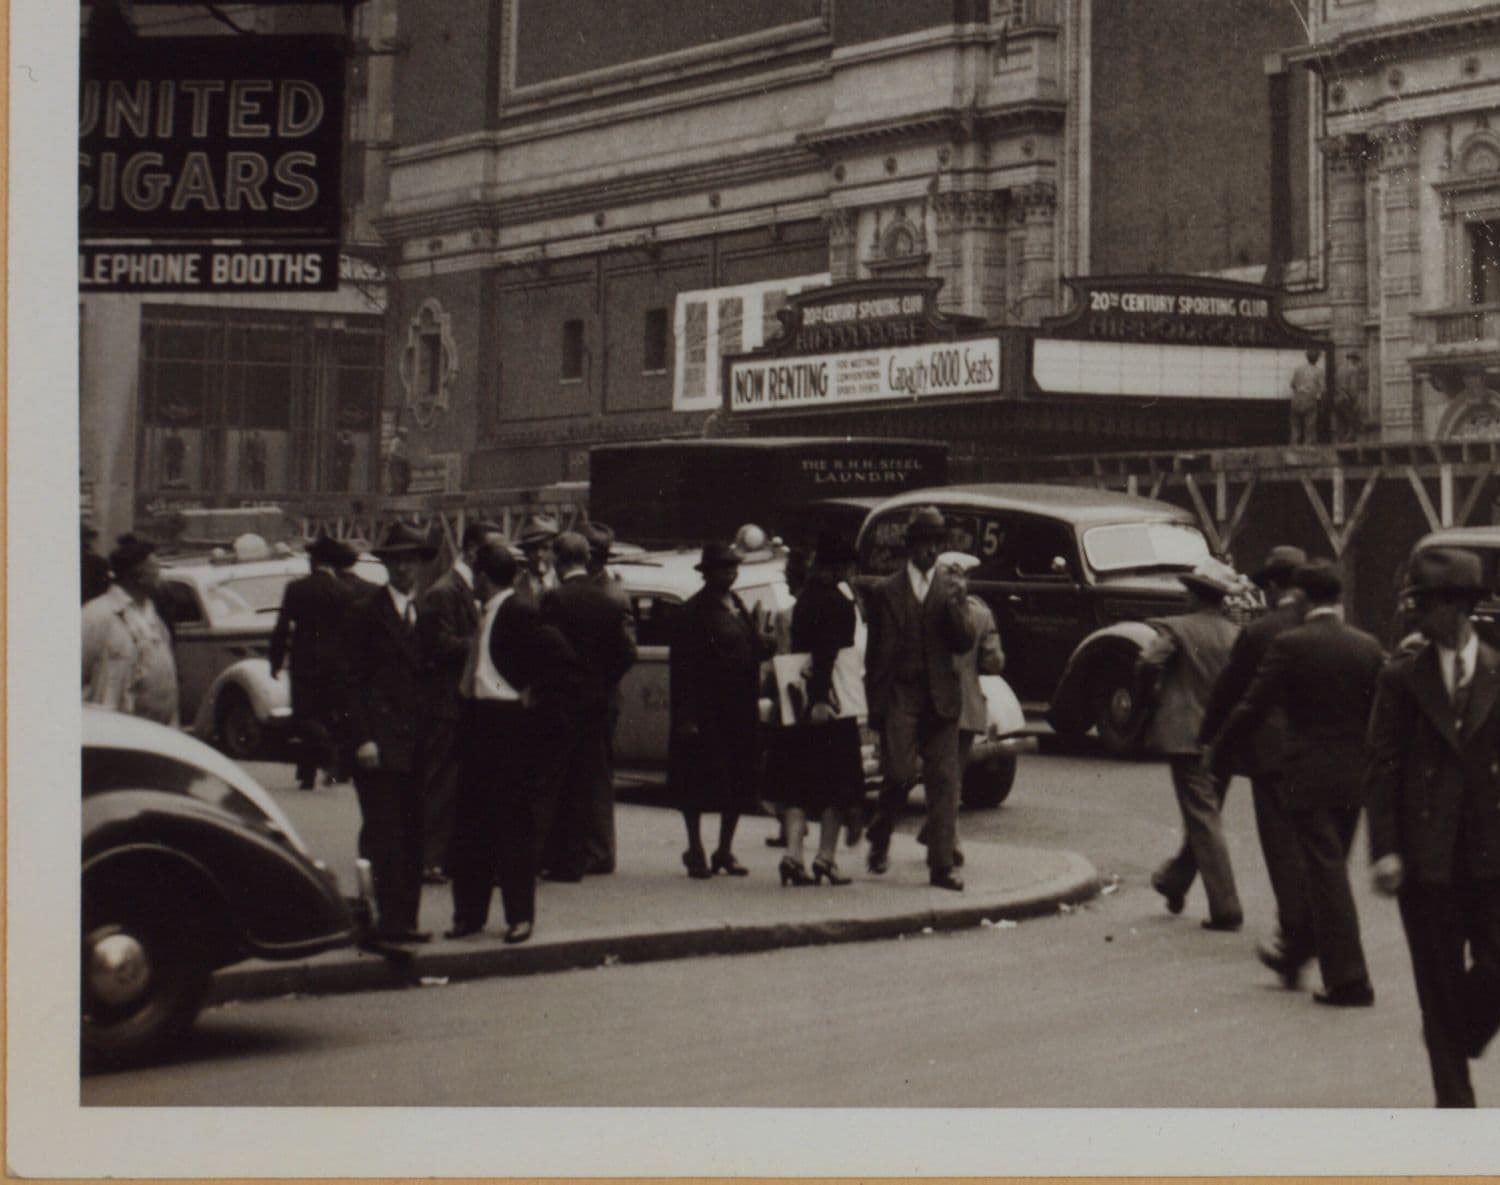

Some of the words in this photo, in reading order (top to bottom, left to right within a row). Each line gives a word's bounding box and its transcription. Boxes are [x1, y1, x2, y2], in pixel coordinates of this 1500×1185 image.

[80, 152, 319, 212] IGARS
[212, 254, 322, 285] BOOTHS
[1121, 293, 1177, 314] CENTURY
[1178, 296, 1237, 317] SPORTING
[1239, 299, 1269, 318] CLUB
[735, 368, 766, 404] NOW
[768, 362, 829, 402] RENTING
[888, 354, 929, 395] Capacity
[931, 349, 961, 389] 6000
[964, 347, 994, 387] Seats
[815, 472, 907, 483] LAUNDRY
